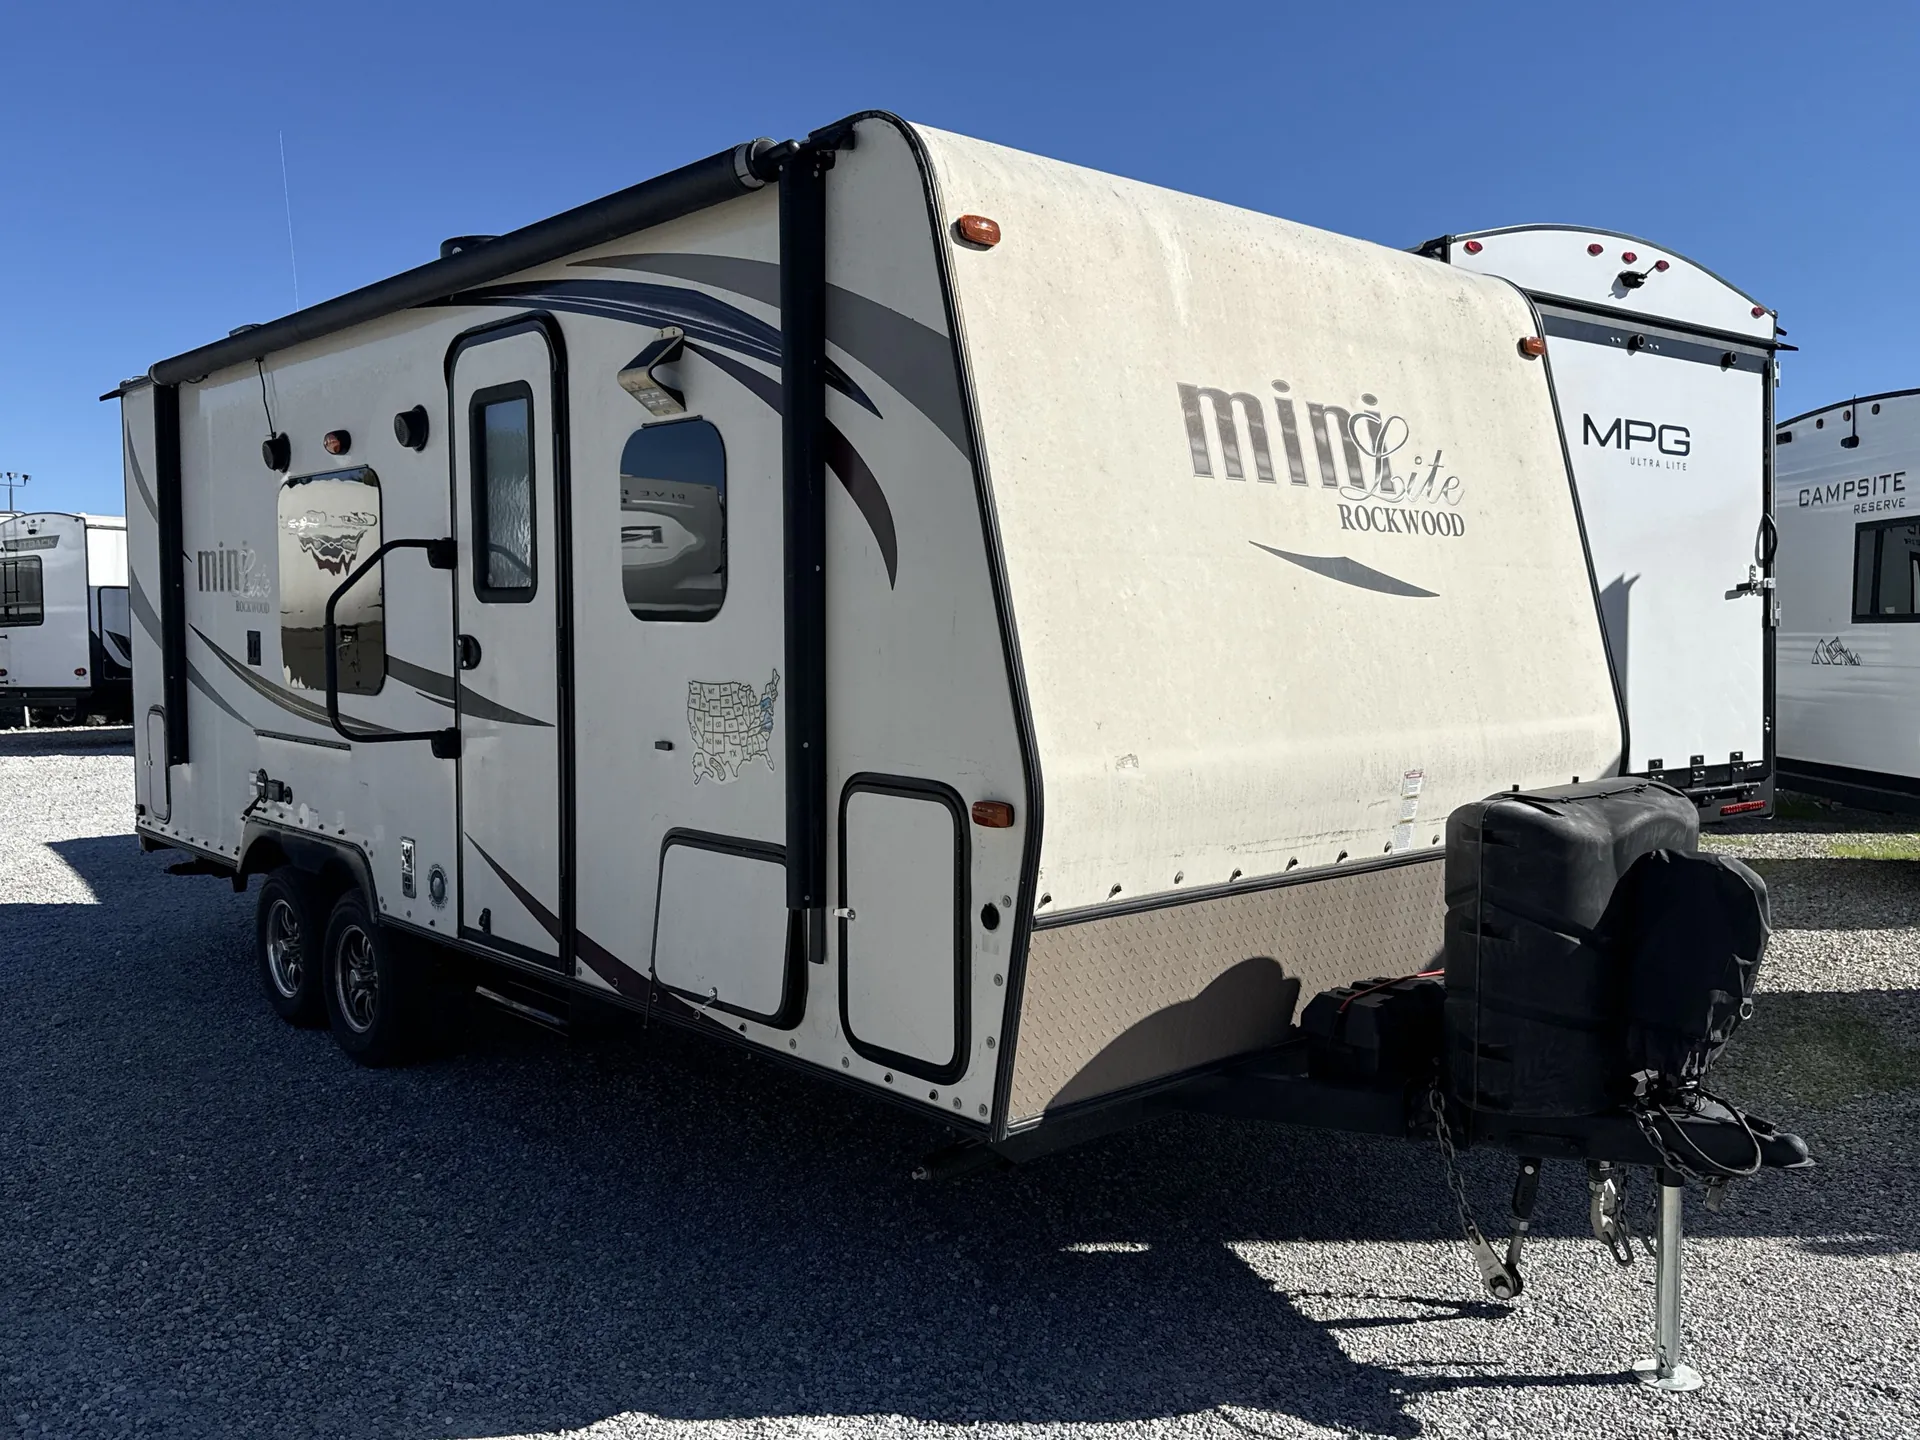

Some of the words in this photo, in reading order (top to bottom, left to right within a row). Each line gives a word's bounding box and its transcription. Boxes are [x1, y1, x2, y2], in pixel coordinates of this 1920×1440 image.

[1176, 378, 1397, 494] mini
[1339, 415, 1466, 506] Lite
[1583, 413, 1691, 457] MPG
[1630, 456, 1661, 469] ULTRA
[1666, 461, 1688, 471] LITE
[1798, 471, 1906, 507] CAMPSITE
[1853, 497, 1906, 515] RESERVE
[1337, 503, 1465, 537] ROCKWOOD
[197, 541, 249, 592] mini
[235, 600, 270, 614] ROCKWOOD
